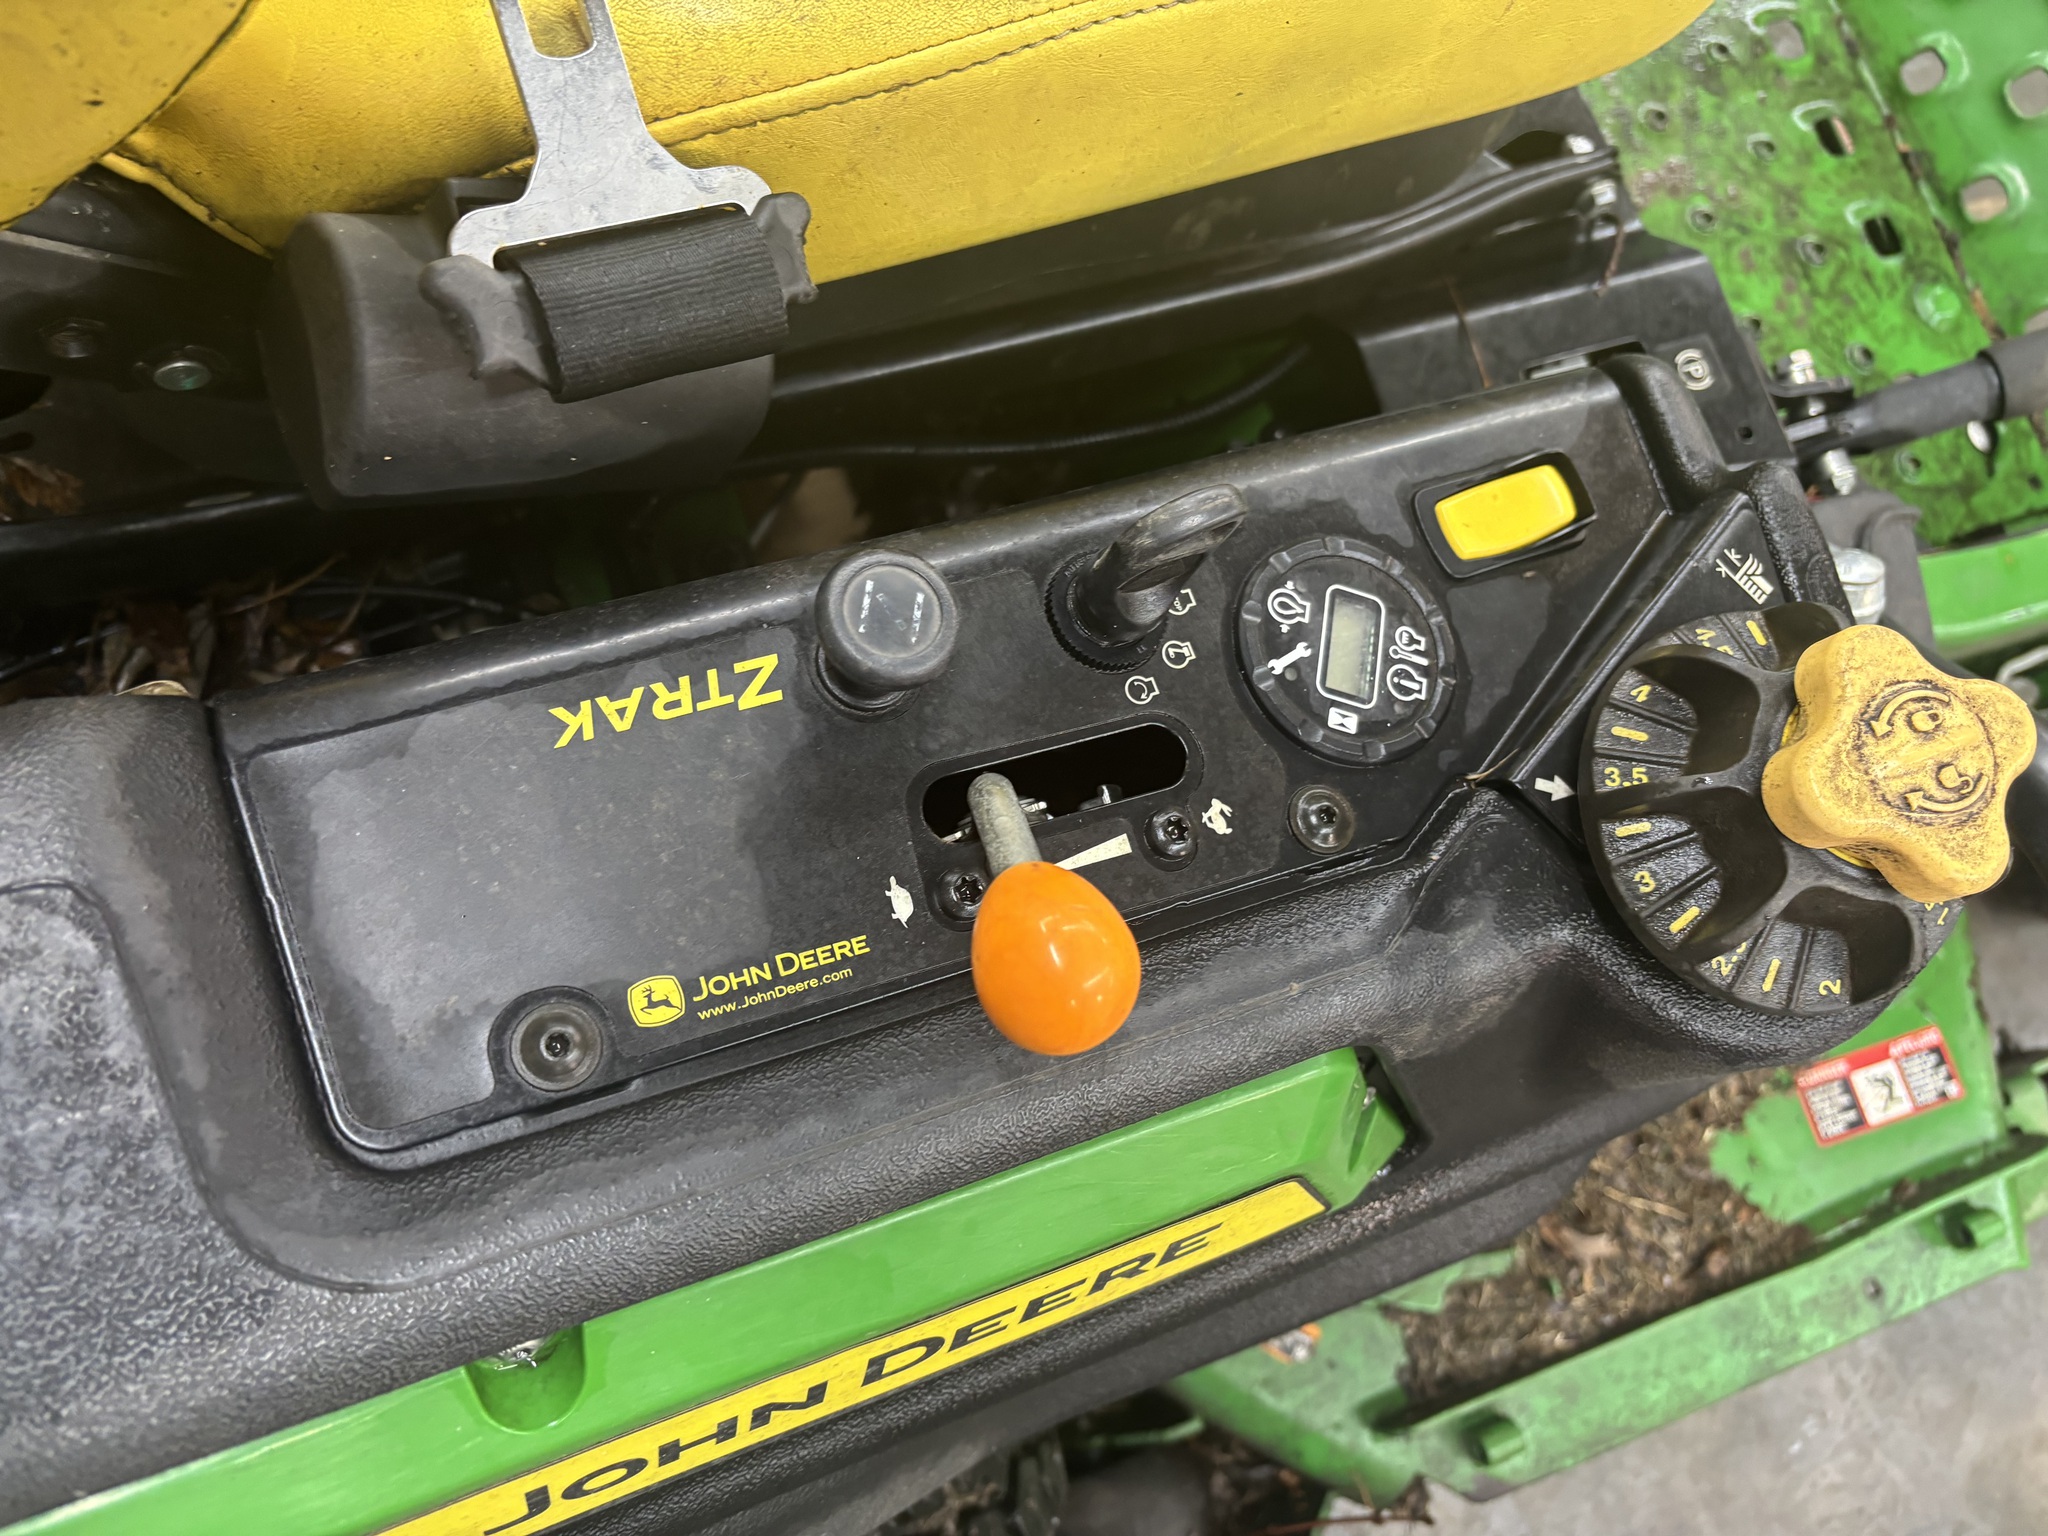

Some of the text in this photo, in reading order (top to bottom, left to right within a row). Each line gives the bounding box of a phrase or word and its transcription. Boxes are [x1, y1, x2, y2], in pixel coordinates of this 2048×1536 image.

[548, 653, 783, 749] ZTRAK
[1604, 766, 1649, 787] 3.5
[1634, 870, 1656, 893] 3
[692, 934, 871, 1002] JOHN DEERE
[697, 967, 853, 1020] www.JohnDeere.com
[1818, 979, 1842, 996] 2
[484, 1222, 1224, 1536] JOHN DEERE
